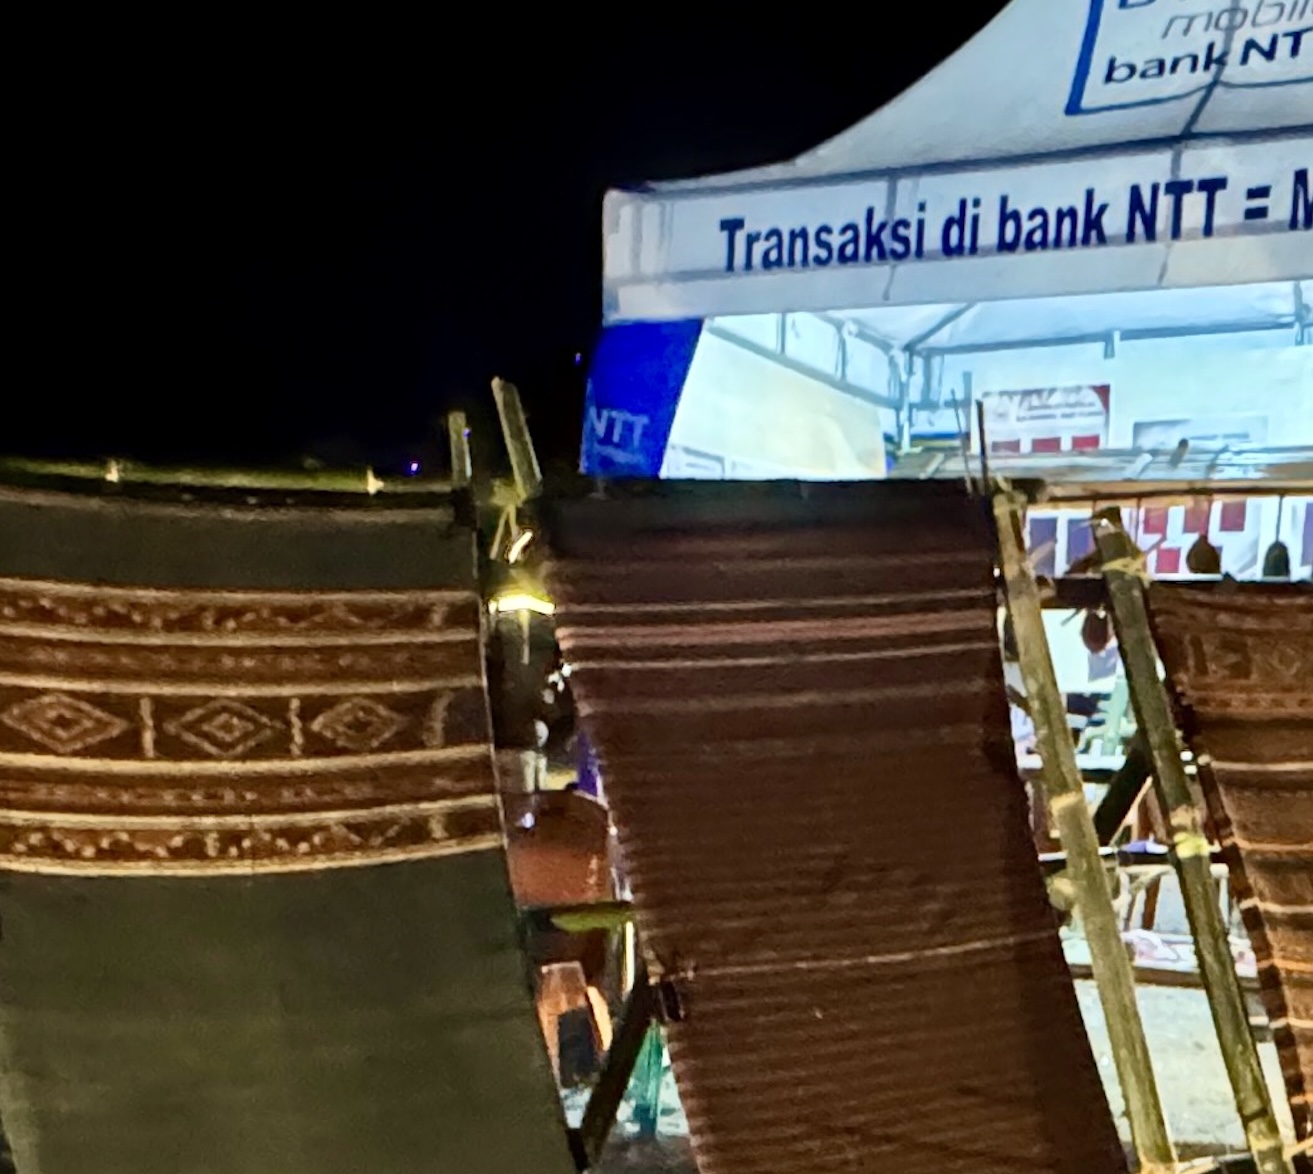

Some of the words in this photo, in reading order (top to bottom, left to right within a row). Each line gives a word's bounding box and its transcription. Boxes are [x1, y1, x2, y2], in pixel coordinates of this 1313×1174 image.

[1104, 41, 1228, 84] bank
[719, 201, 928, 273] Transaksi
[941, 196, 981, 258] di
[996, 187, 1111, 253] bank
[1125, 175, 1229, 243] NTT
[1244, 184, 1272, 220] =
